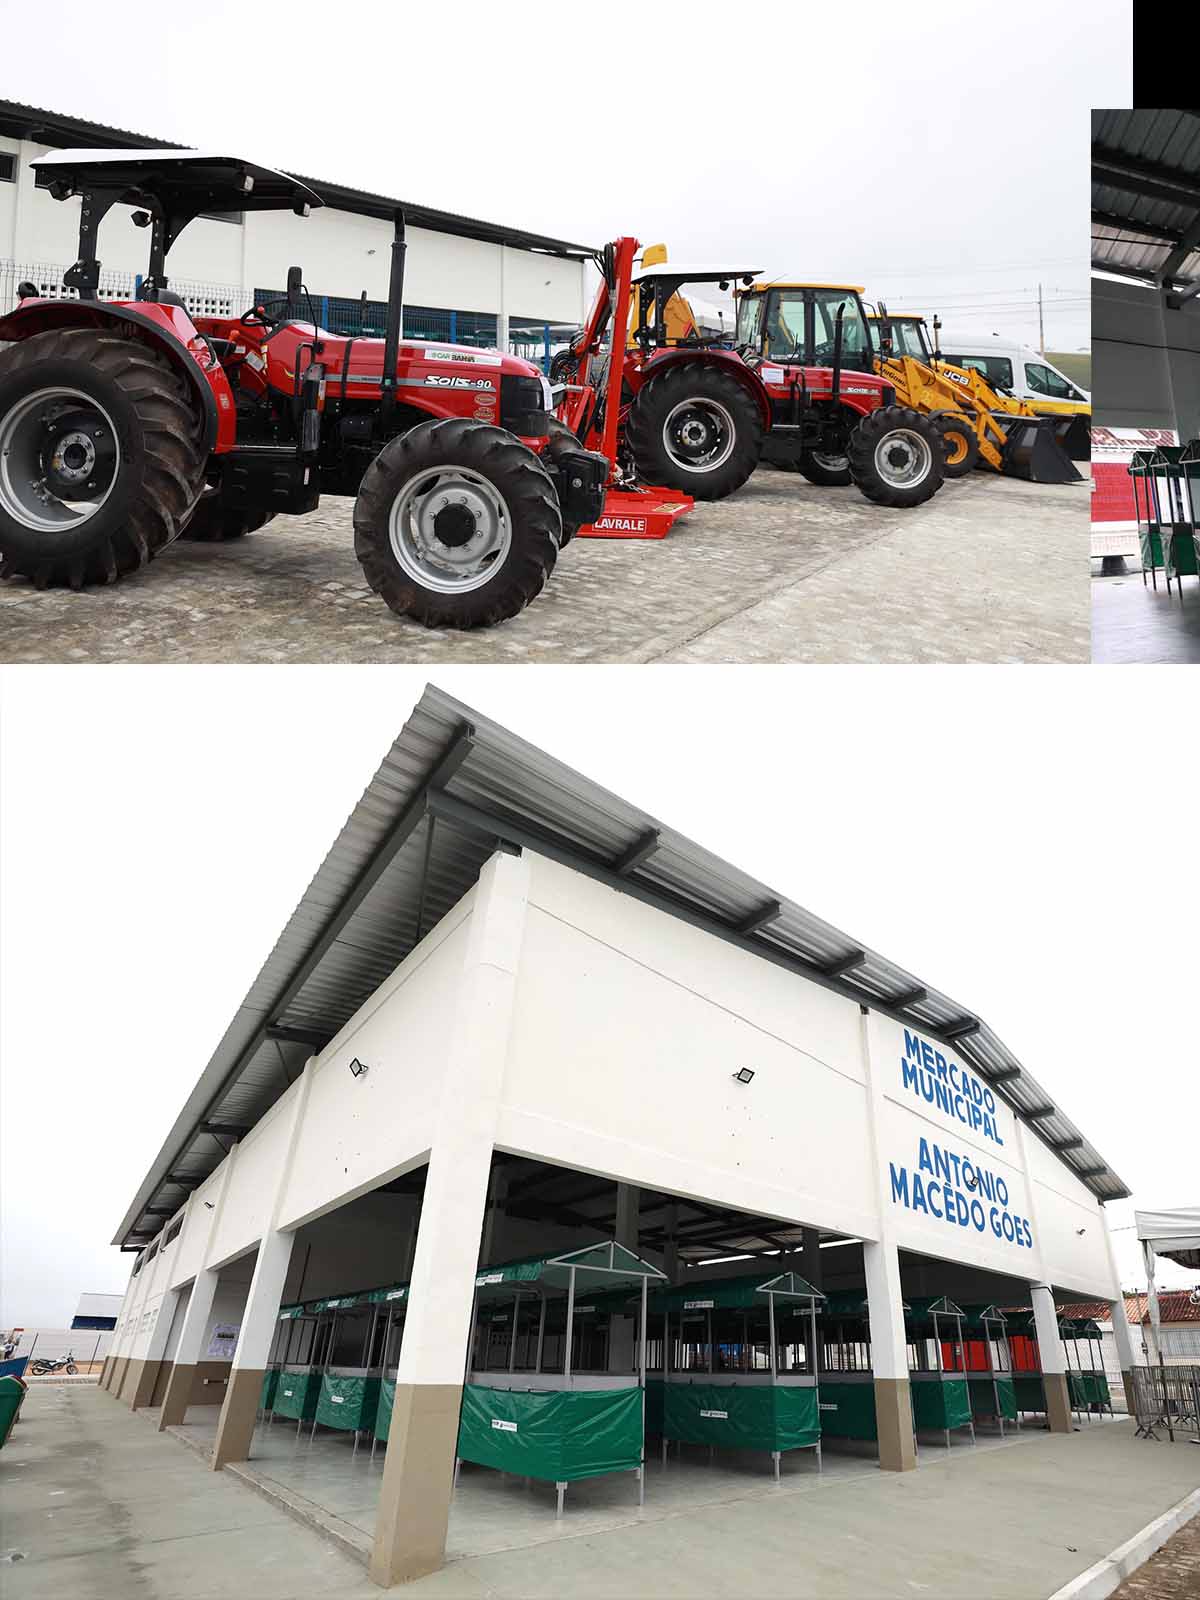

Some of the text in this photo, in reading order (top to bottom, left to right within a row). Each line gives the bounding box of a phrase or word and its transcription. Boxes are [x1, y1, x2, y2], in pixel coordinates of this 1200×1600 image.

[943, 369, 969, 386] JCB
[594, 518, 645, 531] LAVRALE
[901, 1057, 1004, 1146] MUNICIPAL
[904, 1028, 995, 1115] MERCADO
[919, 1136, 1009, 1206] ANTÔNIO
